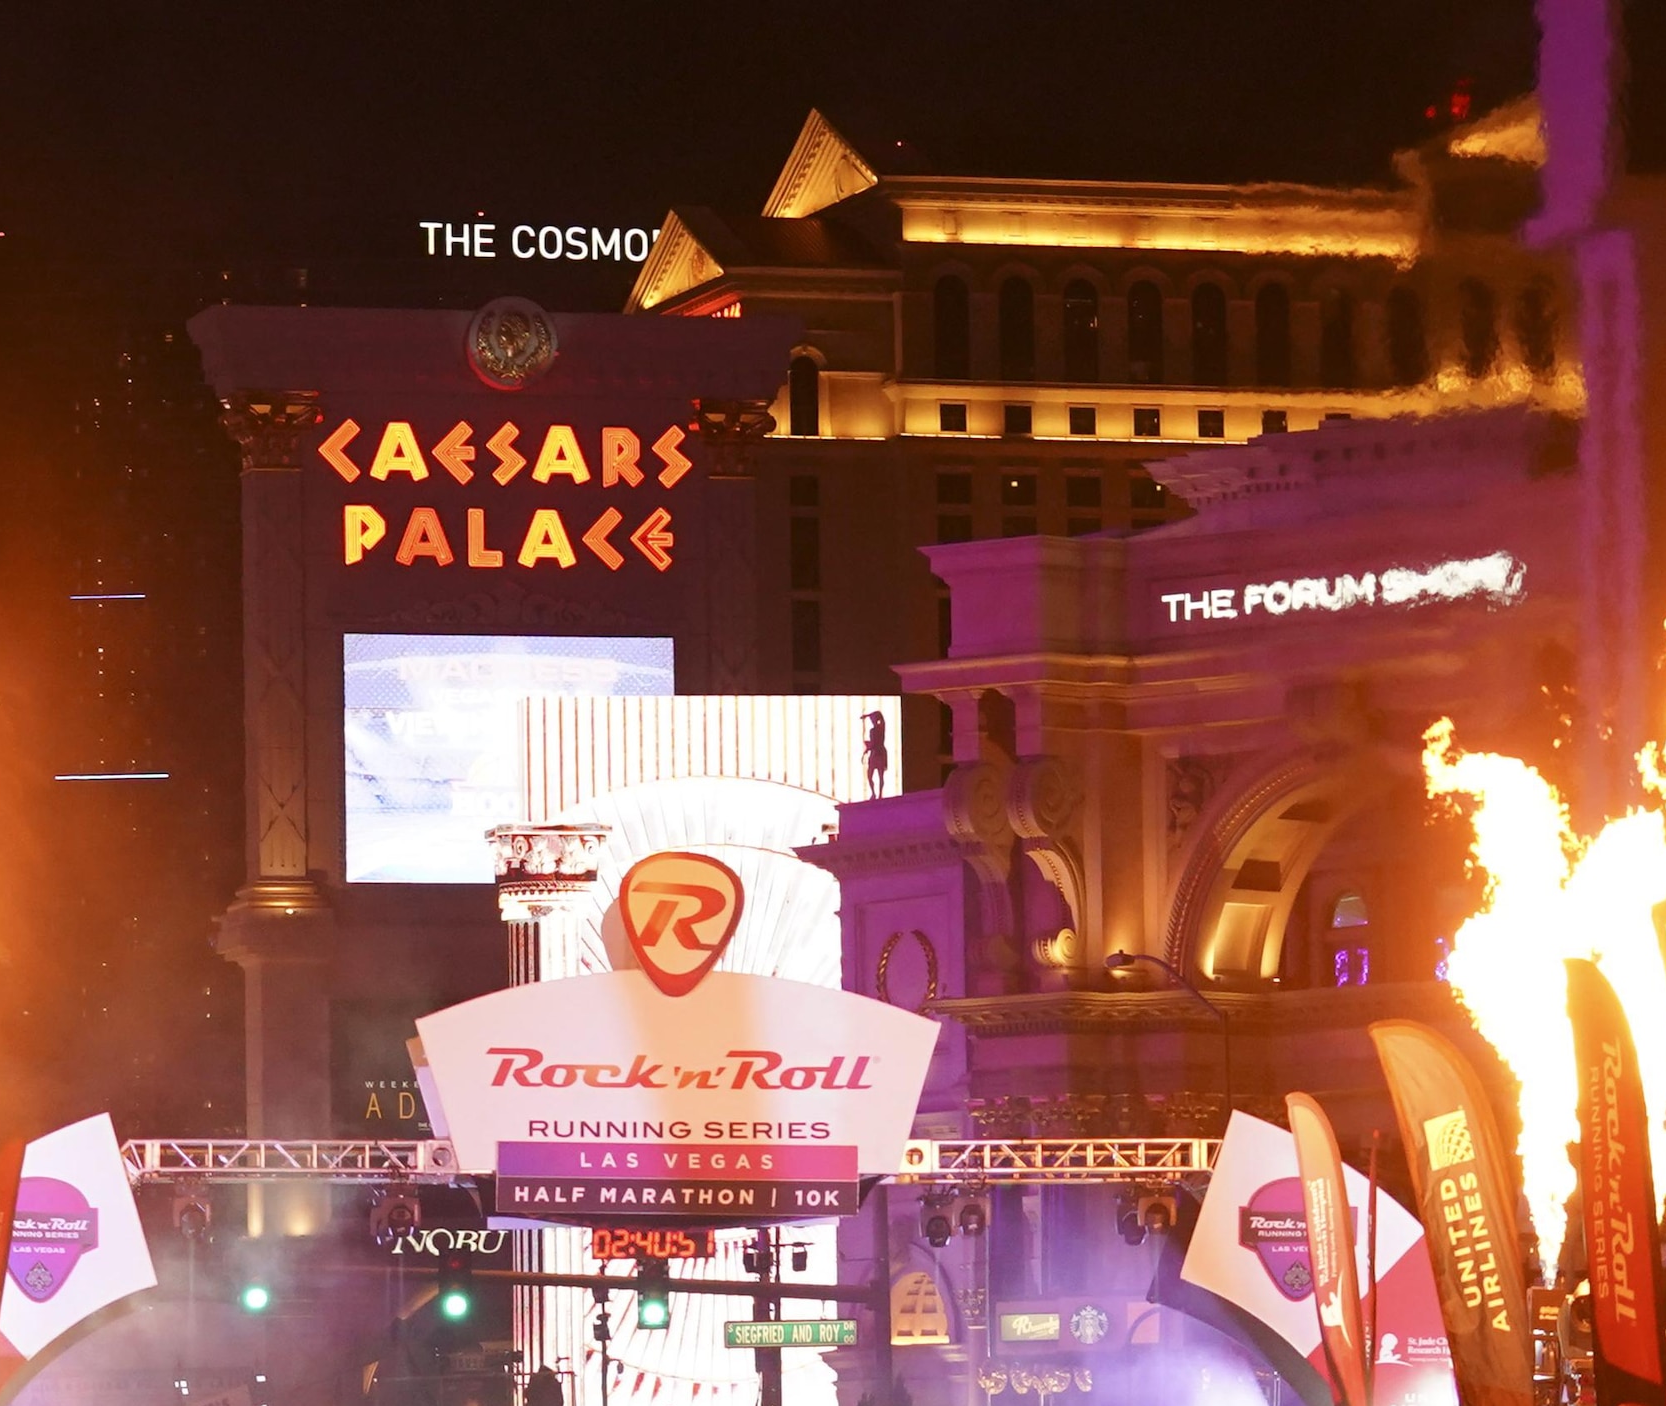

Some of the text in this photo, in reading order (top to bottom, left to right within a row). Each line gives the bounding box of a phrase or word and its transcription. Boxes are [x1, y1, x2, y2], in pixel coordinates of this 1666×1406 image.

[419, 222, 661, 262] THE COSMO
[319, 418, 693, 489] CAESARS
[344, 505, 674, 571] PALACE
[1161, 589, 1238, 622] THE
[1244, 573, 1377, 615] FORUM
[528, 1120, 831, 1140] RUNNING SERIES
[580, 1152, 775, 1170] LAS VEGAS
[1589, 1066, 1610, 1299] RUNNING SERIES
[514, 1186, 840, 1206] HALF MARATHON 10K
[12, 1230, 80, 1240] NNING SERIES
[391, 1228, 508, 1257] NOBU
[1258, 1230, 1303, 1238] RUNNING
[1440, 1178, 1482, 1308] UNITED
[13, 1246, 66, 1254] LAS VEGAS
[1272, 1245, 1291, 1253] LAS
[1459, 1172, 1511, 1331] AIRLINES
[735, 1325, 785, 1345] SIEGFRIED
[792, 1325, 813, 1343] AND
[819, 1324, 841, 1343] ROY
